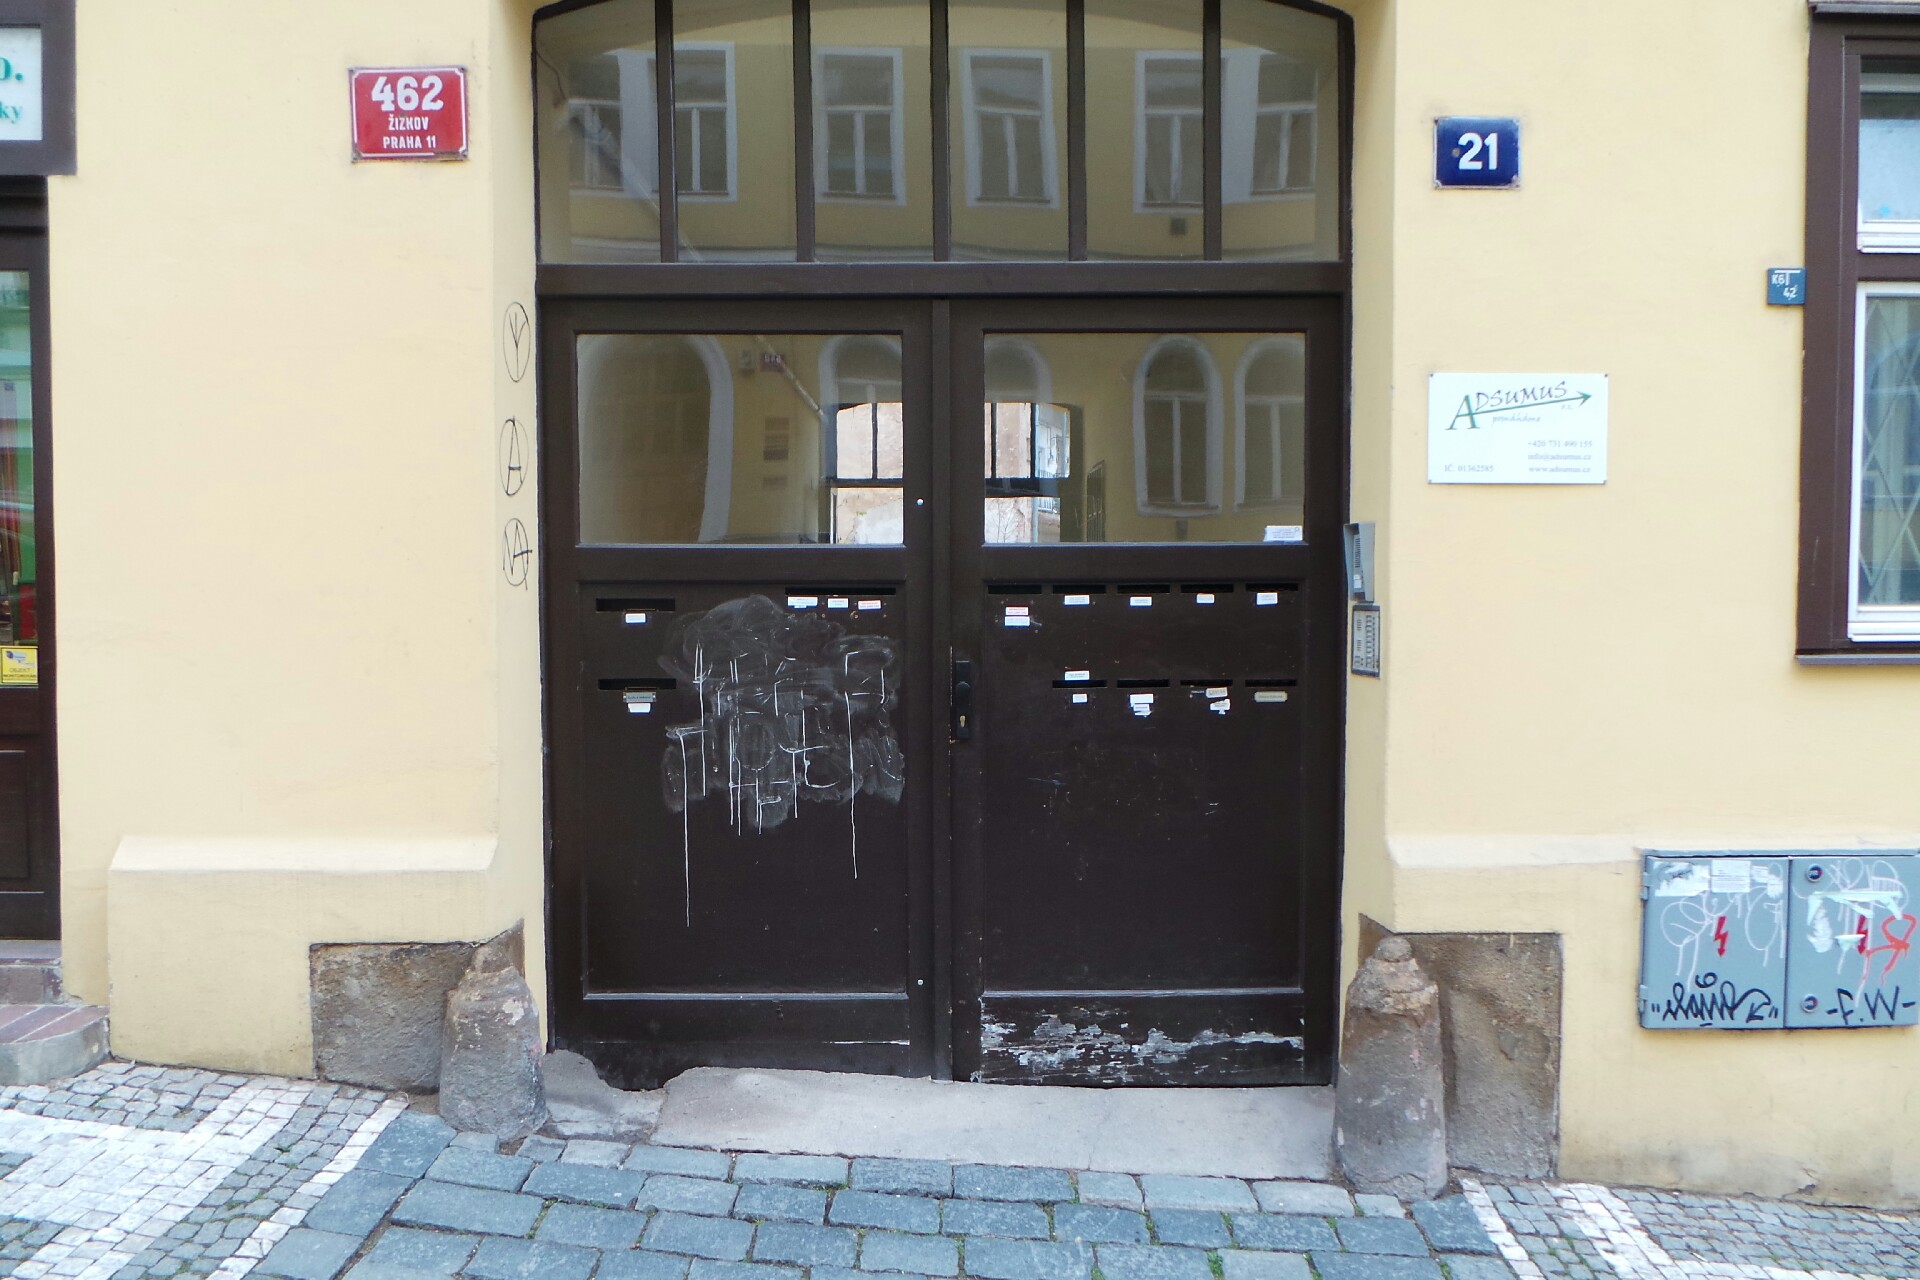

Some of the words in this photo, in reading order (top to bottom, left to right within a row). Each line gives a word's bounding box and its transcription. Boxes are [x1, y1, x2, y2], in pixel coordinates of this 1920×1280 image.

[371, 75, 444, 112] 462
[382, 135, 422, 149] PRAHA
[426, 135, 437, 149] 11
[1458, 132, 1498, 170] 21
[1445, 380, 1568, 430] ADSUMUS
